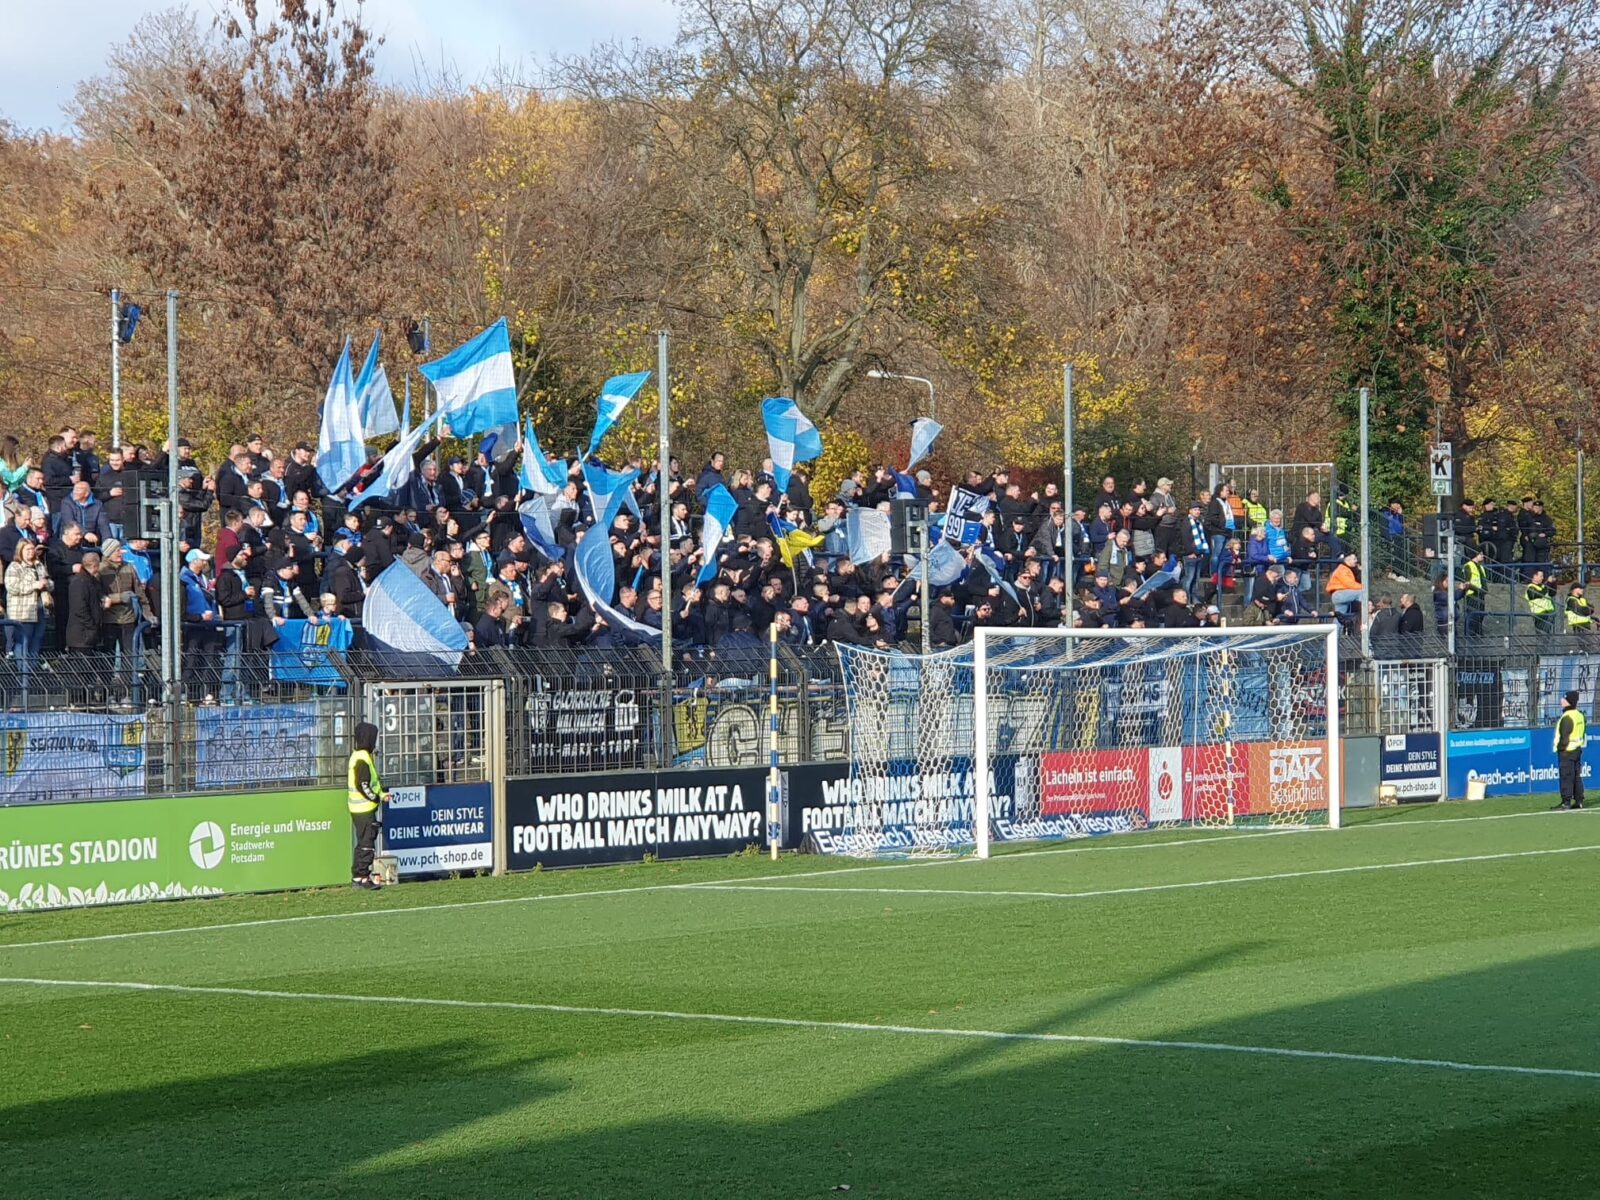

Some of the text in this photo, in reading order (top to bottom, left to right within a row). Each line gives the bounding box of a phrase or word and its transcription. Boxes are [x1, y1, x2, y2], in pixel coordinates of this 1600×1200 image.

[1434, 453, 1448, 476] K
[946, 514, 961, 537] 99
[385, 704, 396, 731] 3
[1408, 750, 1437, 761] DEIN STYLE
[1046, 766, 1136, 785] Lächeln ist einfach.
[1270, 754, 1323, 783] DAK
[1386, 761, 1437, 773] DEINE WORKWEAR
[402, 792, 421, 802] PCH
[821, 779, 862, 804] WHO
[866, 775, 920, 800] DRINKS
[923, 772, 961, 797] MILK
[1270, 783, 1324, 803] Gesundheit
[1397, 781, 1437, 794] w.pch-shop.de
[536, 785, 743, 822] WHO DRINKS MILK AT A
[432, 807, 484, 822] DEIN STYLE
[802, 804, 882, 833] FOOTBALL
[883, 800, 935, 827] MATCH
[231, 819, 332, 836] Energie und Wasser
[390, 822, 484, 840] DEINE WORKWEAR
[513, 811, 762, 854] FOOTBALL MATCH ANYWAY?
[1000, 815, 1078, 839] Eisenbach
[231, 840, 275, 850] Stadtwerke
[814, 826, 910, 853] Eisenbach
[70, 837, 157, 864] STADION
[231, 853, 265, 864] Potsdam
[398, 848, 484, 868] ww.pch-shop.de
